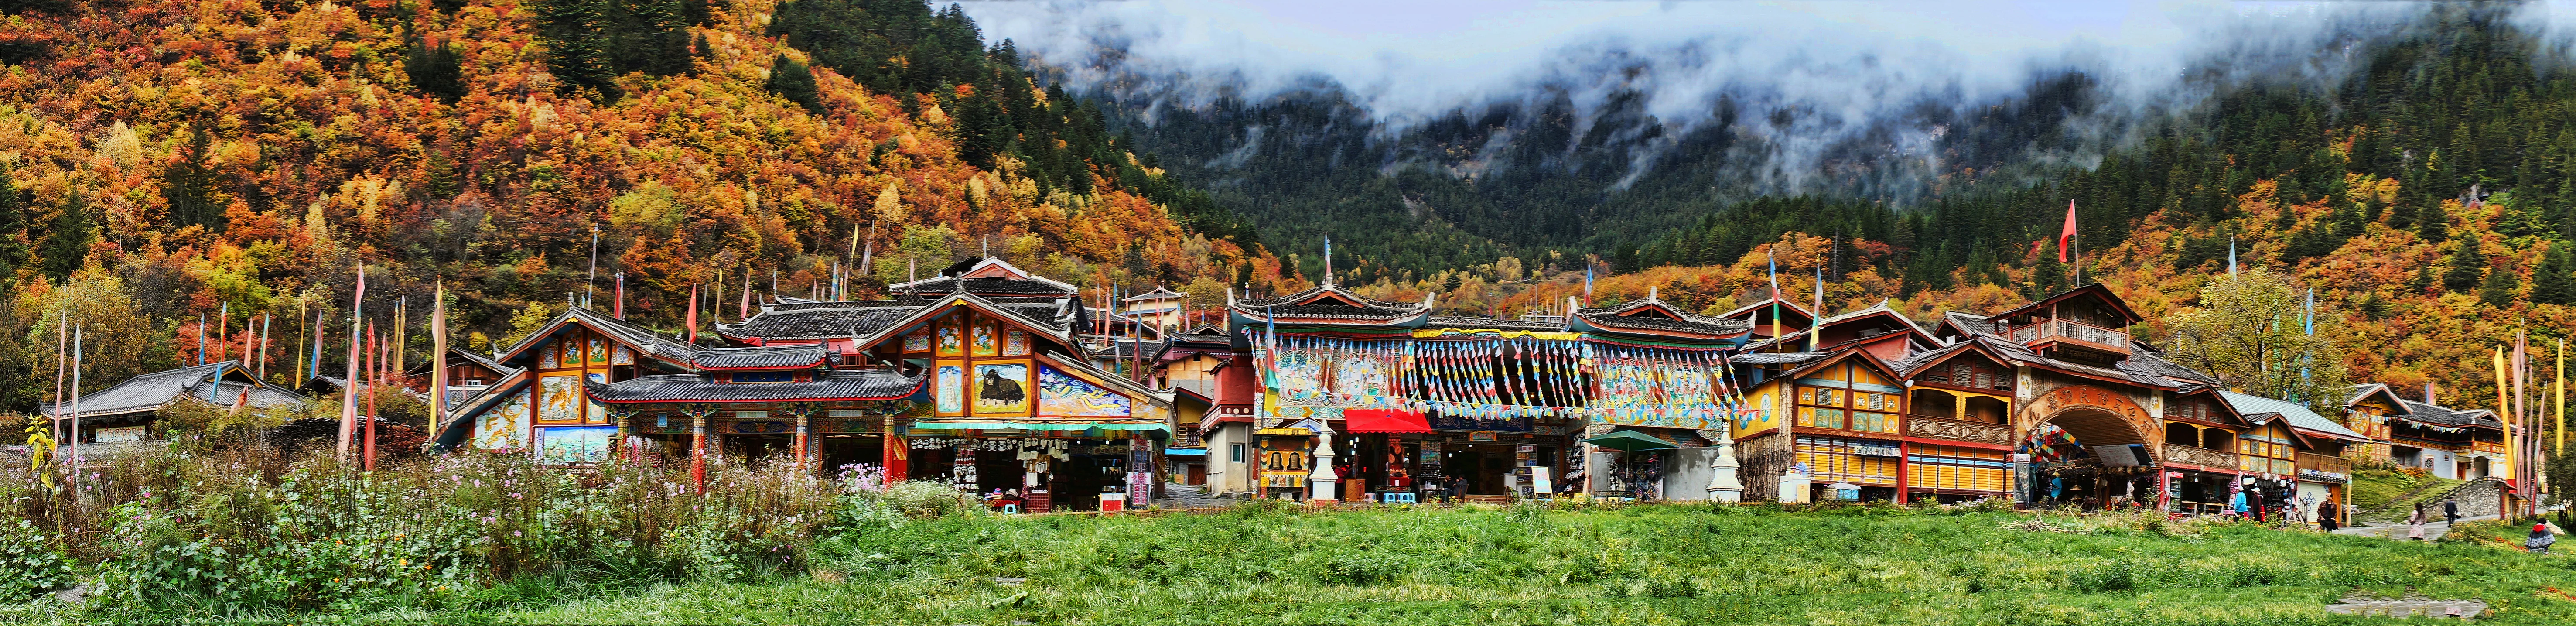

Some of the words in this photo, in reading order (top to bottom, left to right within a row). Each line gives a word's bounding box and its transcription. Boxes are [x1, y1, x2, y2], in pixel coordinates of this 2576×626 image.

[2028, 387, 2153, 435] 九寨沟民俗文化村
